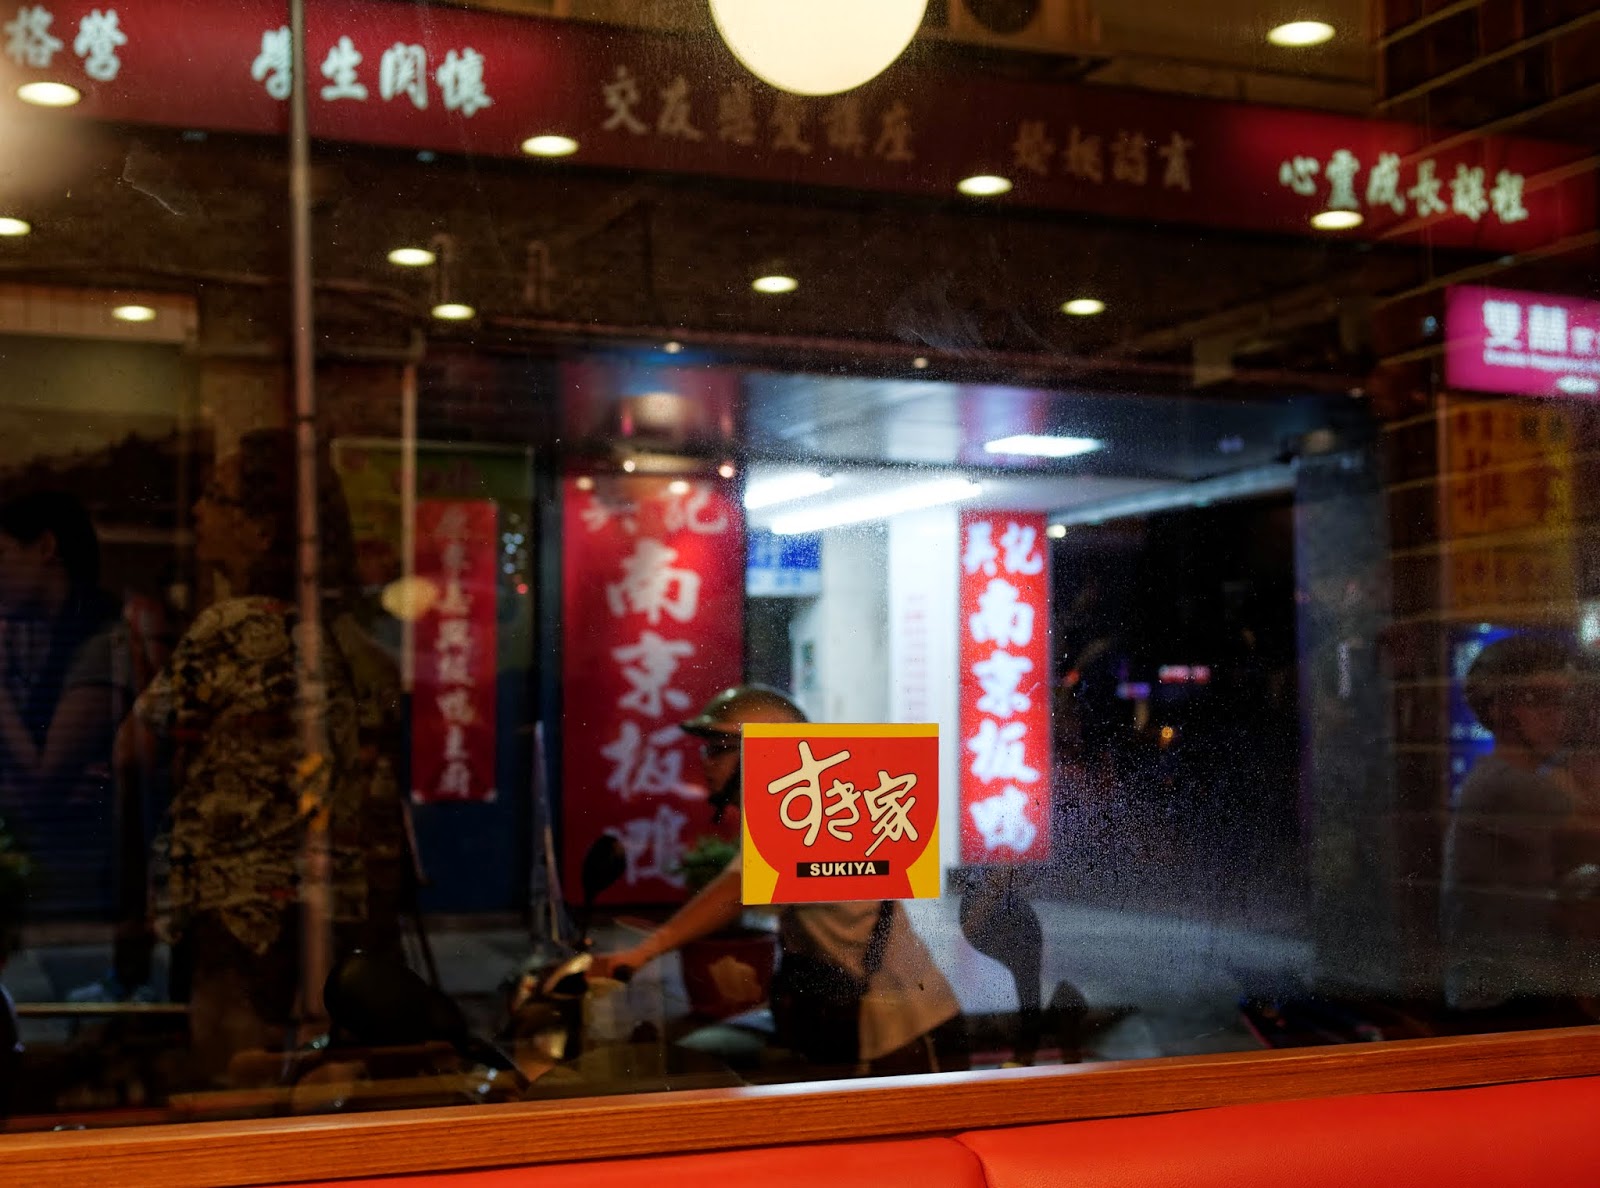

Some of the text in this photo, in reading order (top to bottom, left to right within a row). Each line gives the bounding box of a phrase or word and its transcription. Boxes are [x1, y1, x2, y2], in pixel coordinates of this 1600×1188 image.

[968, 578, 1040, 854] 南京板鴨
[767, 740, 919, 857] すき家
[809, 861, 877, 877] SUKIYA
